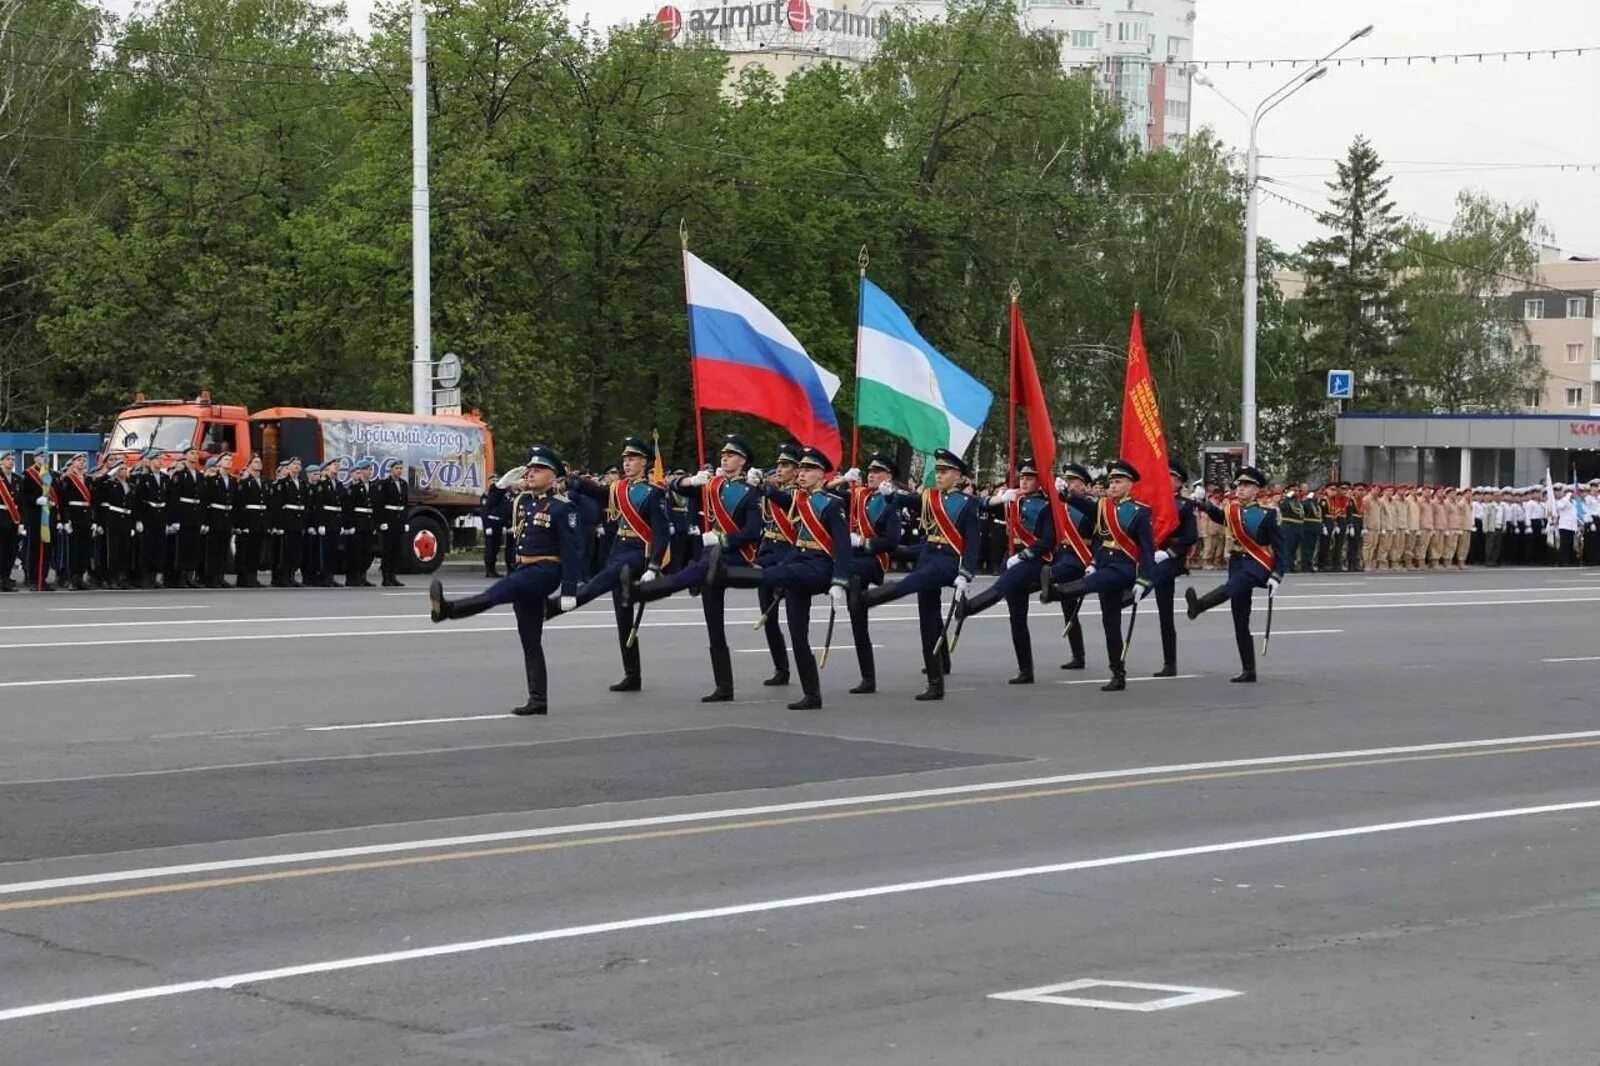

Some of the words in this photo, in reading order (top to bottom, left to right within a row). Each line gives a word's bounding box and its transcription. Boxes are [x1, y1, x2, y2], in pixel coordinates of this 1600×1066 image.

[689, 0, 784, 32] azimut
[816, 8, 887, 40] azimu
[349, 424, 421, 446] Любимый
[424, 430, 473, 457] город
[420, 459, 482, 489] УФА
